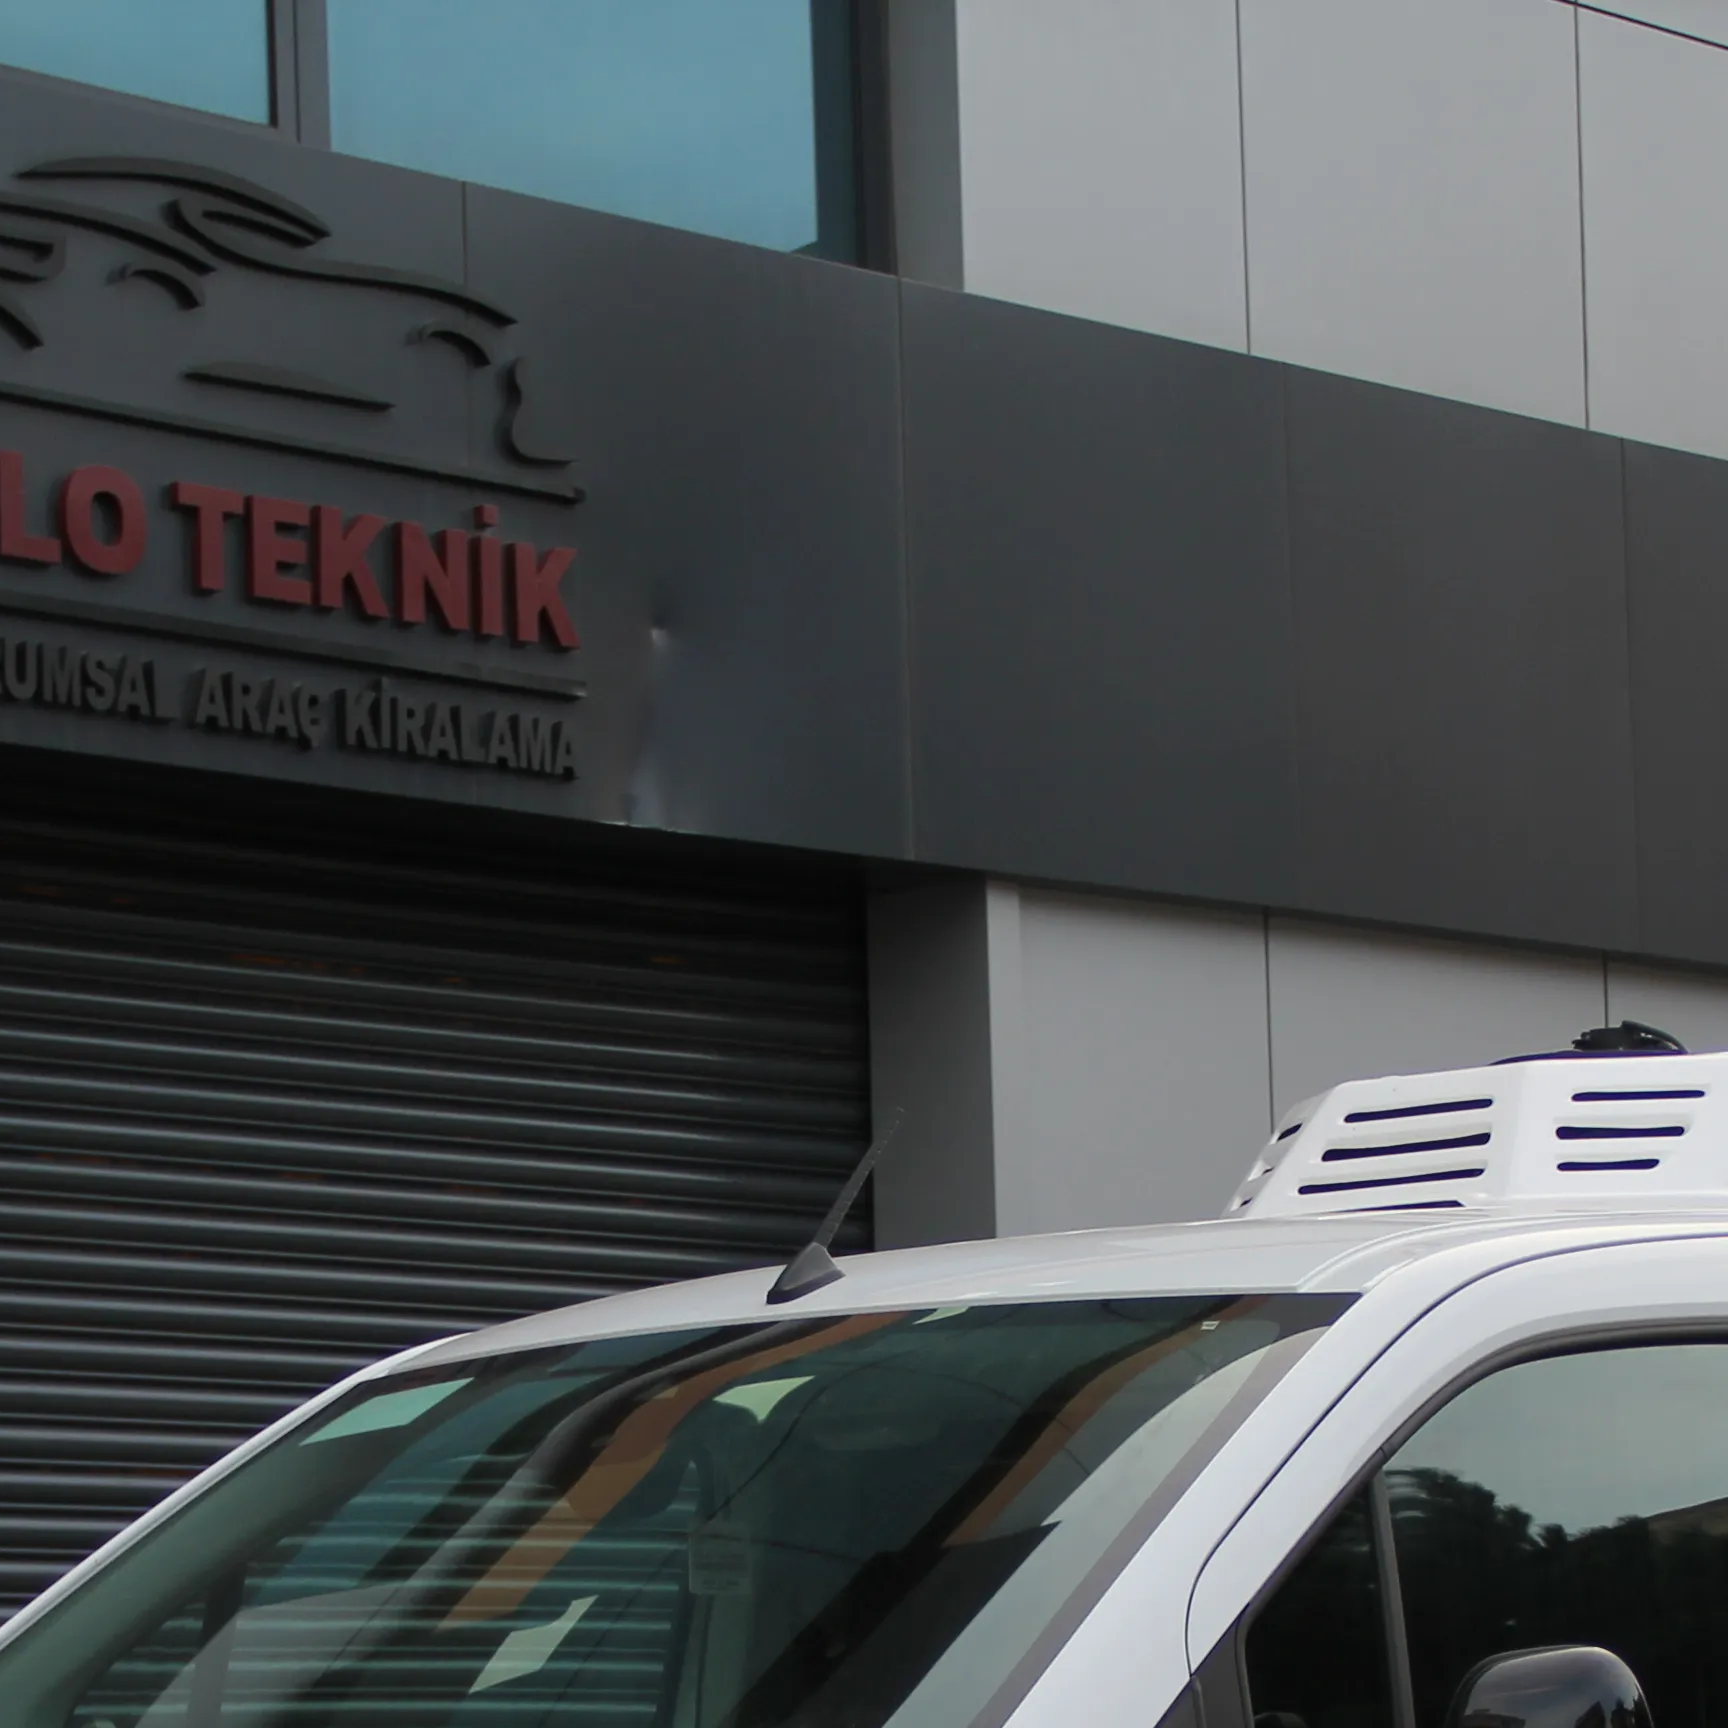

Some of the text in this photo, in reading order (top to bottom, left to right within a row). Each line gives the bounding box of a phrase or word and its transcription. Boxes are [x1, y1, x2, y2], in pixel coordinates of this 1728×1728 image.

[168, 482, 582, 651] TEKNİK
[194, 665, 326, 751] ARAÇ
[342, 677, 578, 780] KİRALAMA
